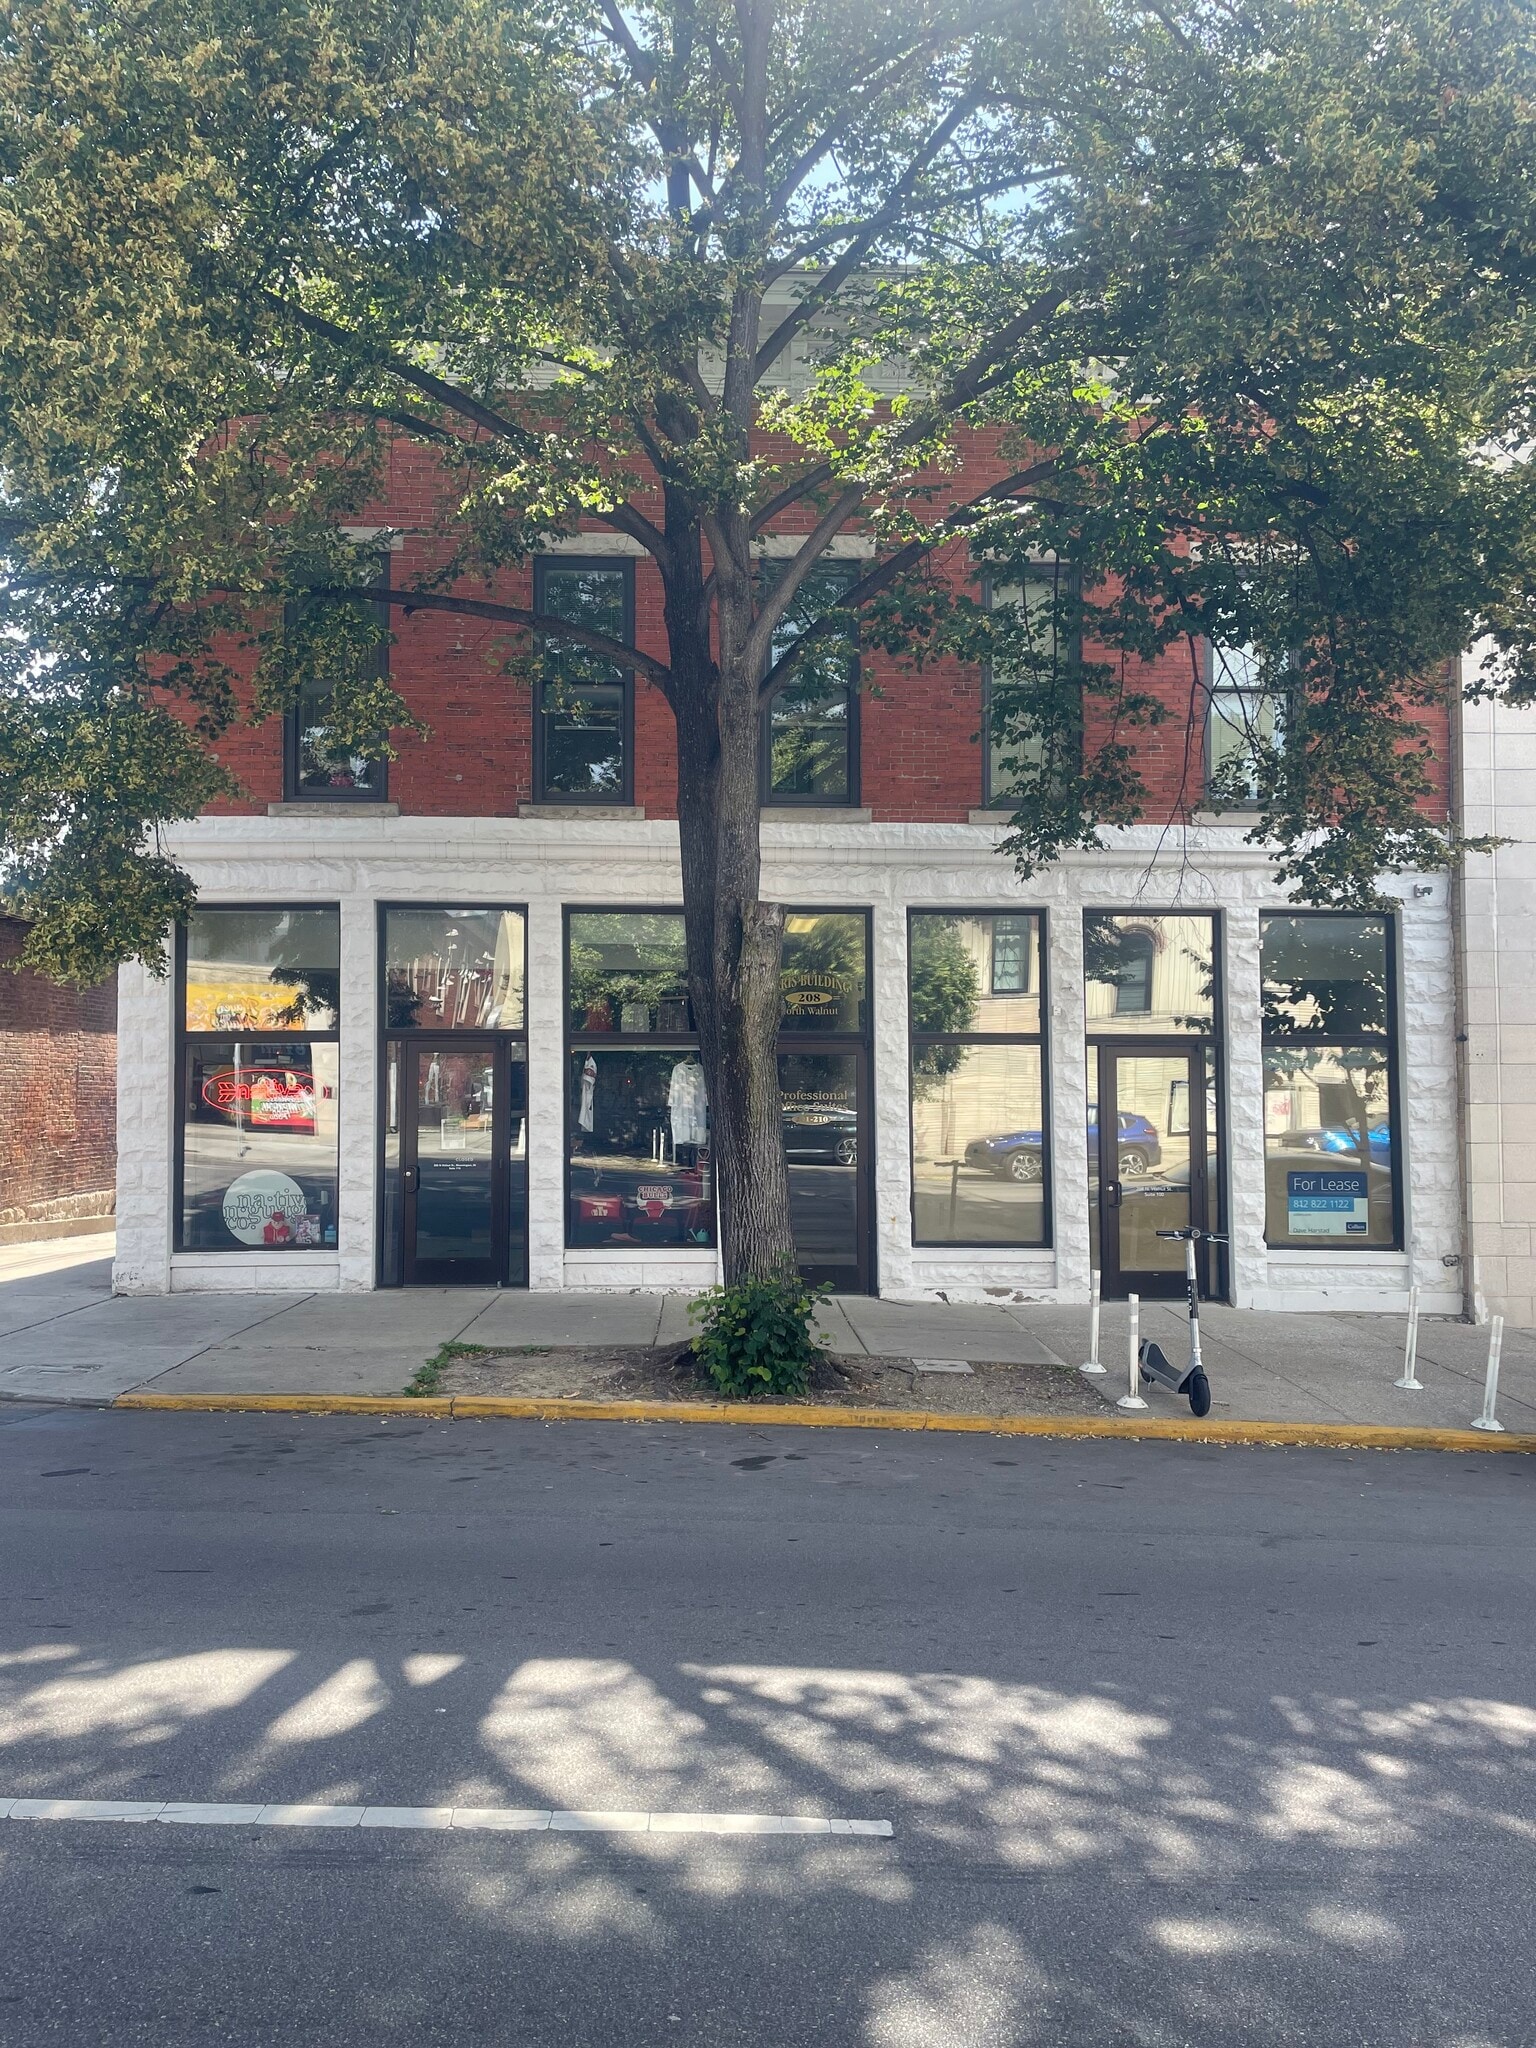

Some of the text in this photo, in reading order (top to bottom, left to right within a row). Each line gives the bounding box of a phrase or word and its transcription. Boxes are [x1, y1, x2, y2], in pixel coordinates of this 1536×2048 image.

[800, 974, 850, 993] BUILDING
[798, 993, 821, 1002] 208
[786, 1006, 839, 1016] orth Walnut
[779, 1090, 848, 1100] Professional
[812, 1101, 849, 1112] Suites
[637, 1185, 673, 1193] CHICAGO
[1293, 1177, 1360, 1191] For Lease
[1293, 1199, 1349, 1209] 812 822 1122
